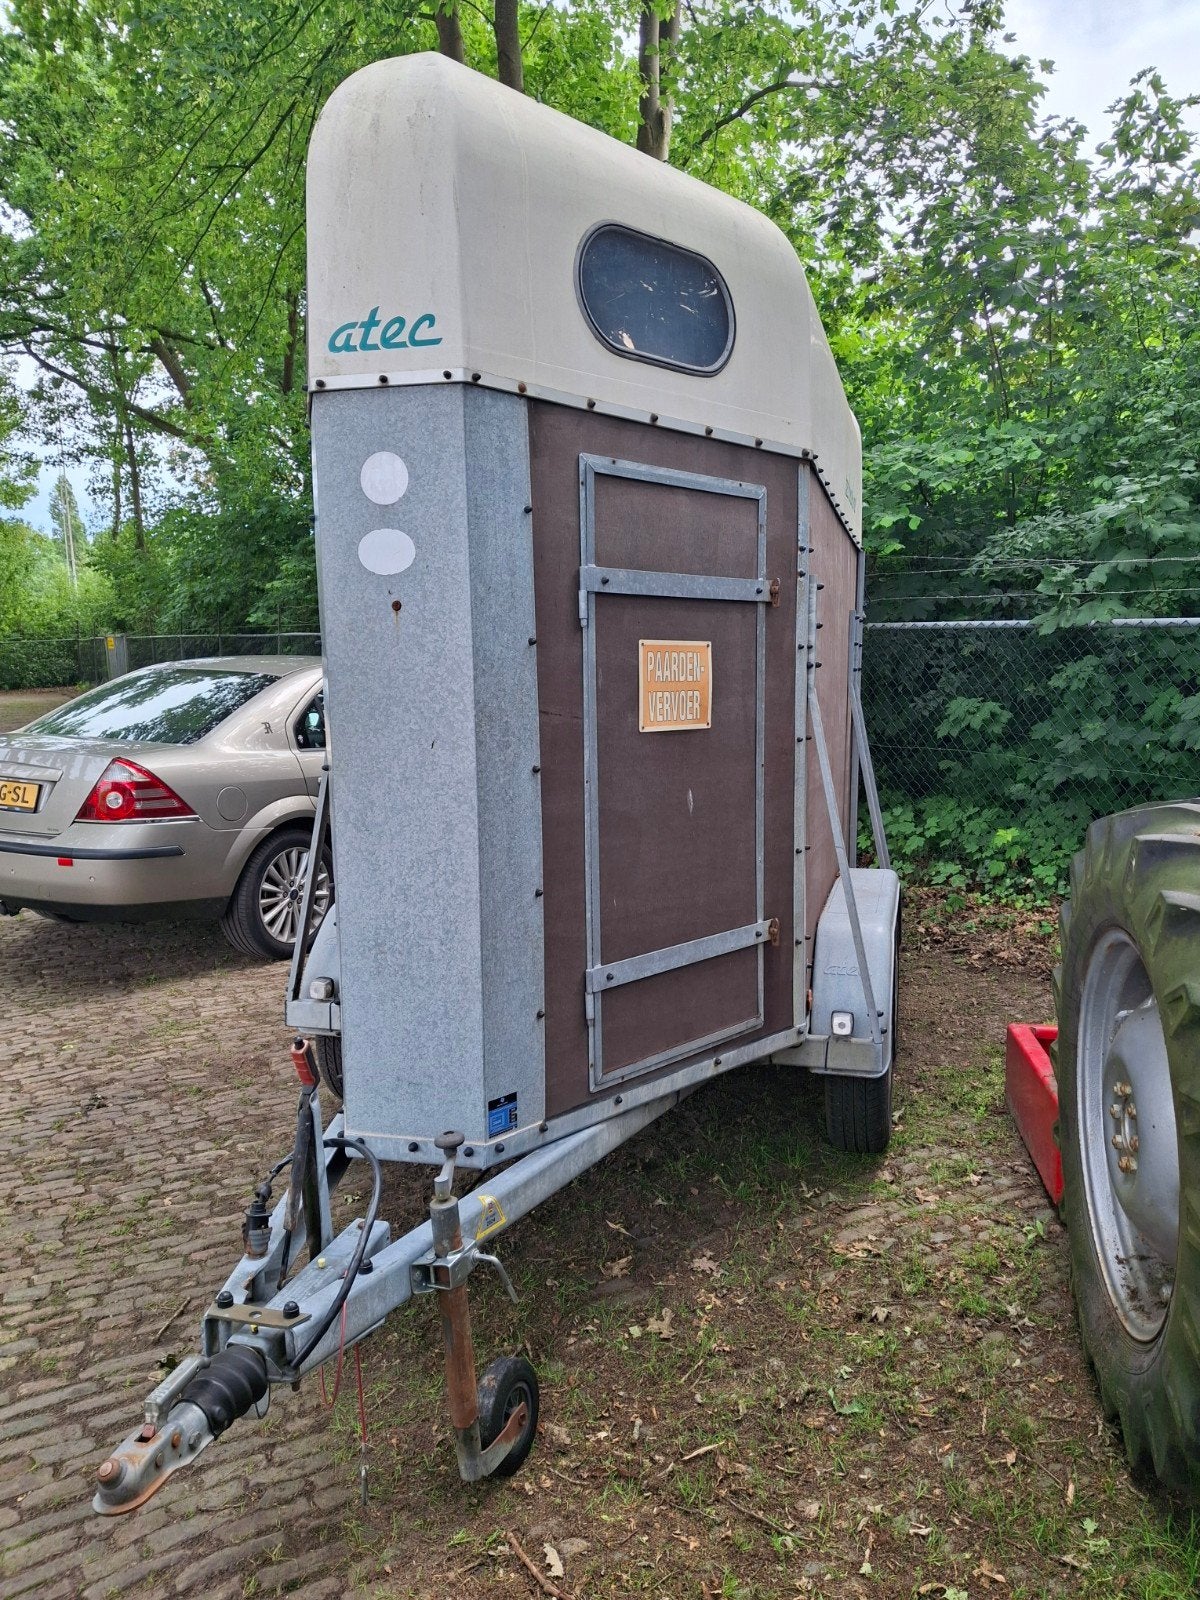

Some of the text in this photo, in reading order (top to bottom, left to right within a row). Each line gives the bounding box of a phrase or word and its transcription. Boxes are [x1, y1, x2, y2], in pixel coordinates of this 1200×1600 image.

[328, 305, 443, 354] atec
[647, 650, 705, 682] PAARDEN-
[648, 690, 701, 722] VERVOER
